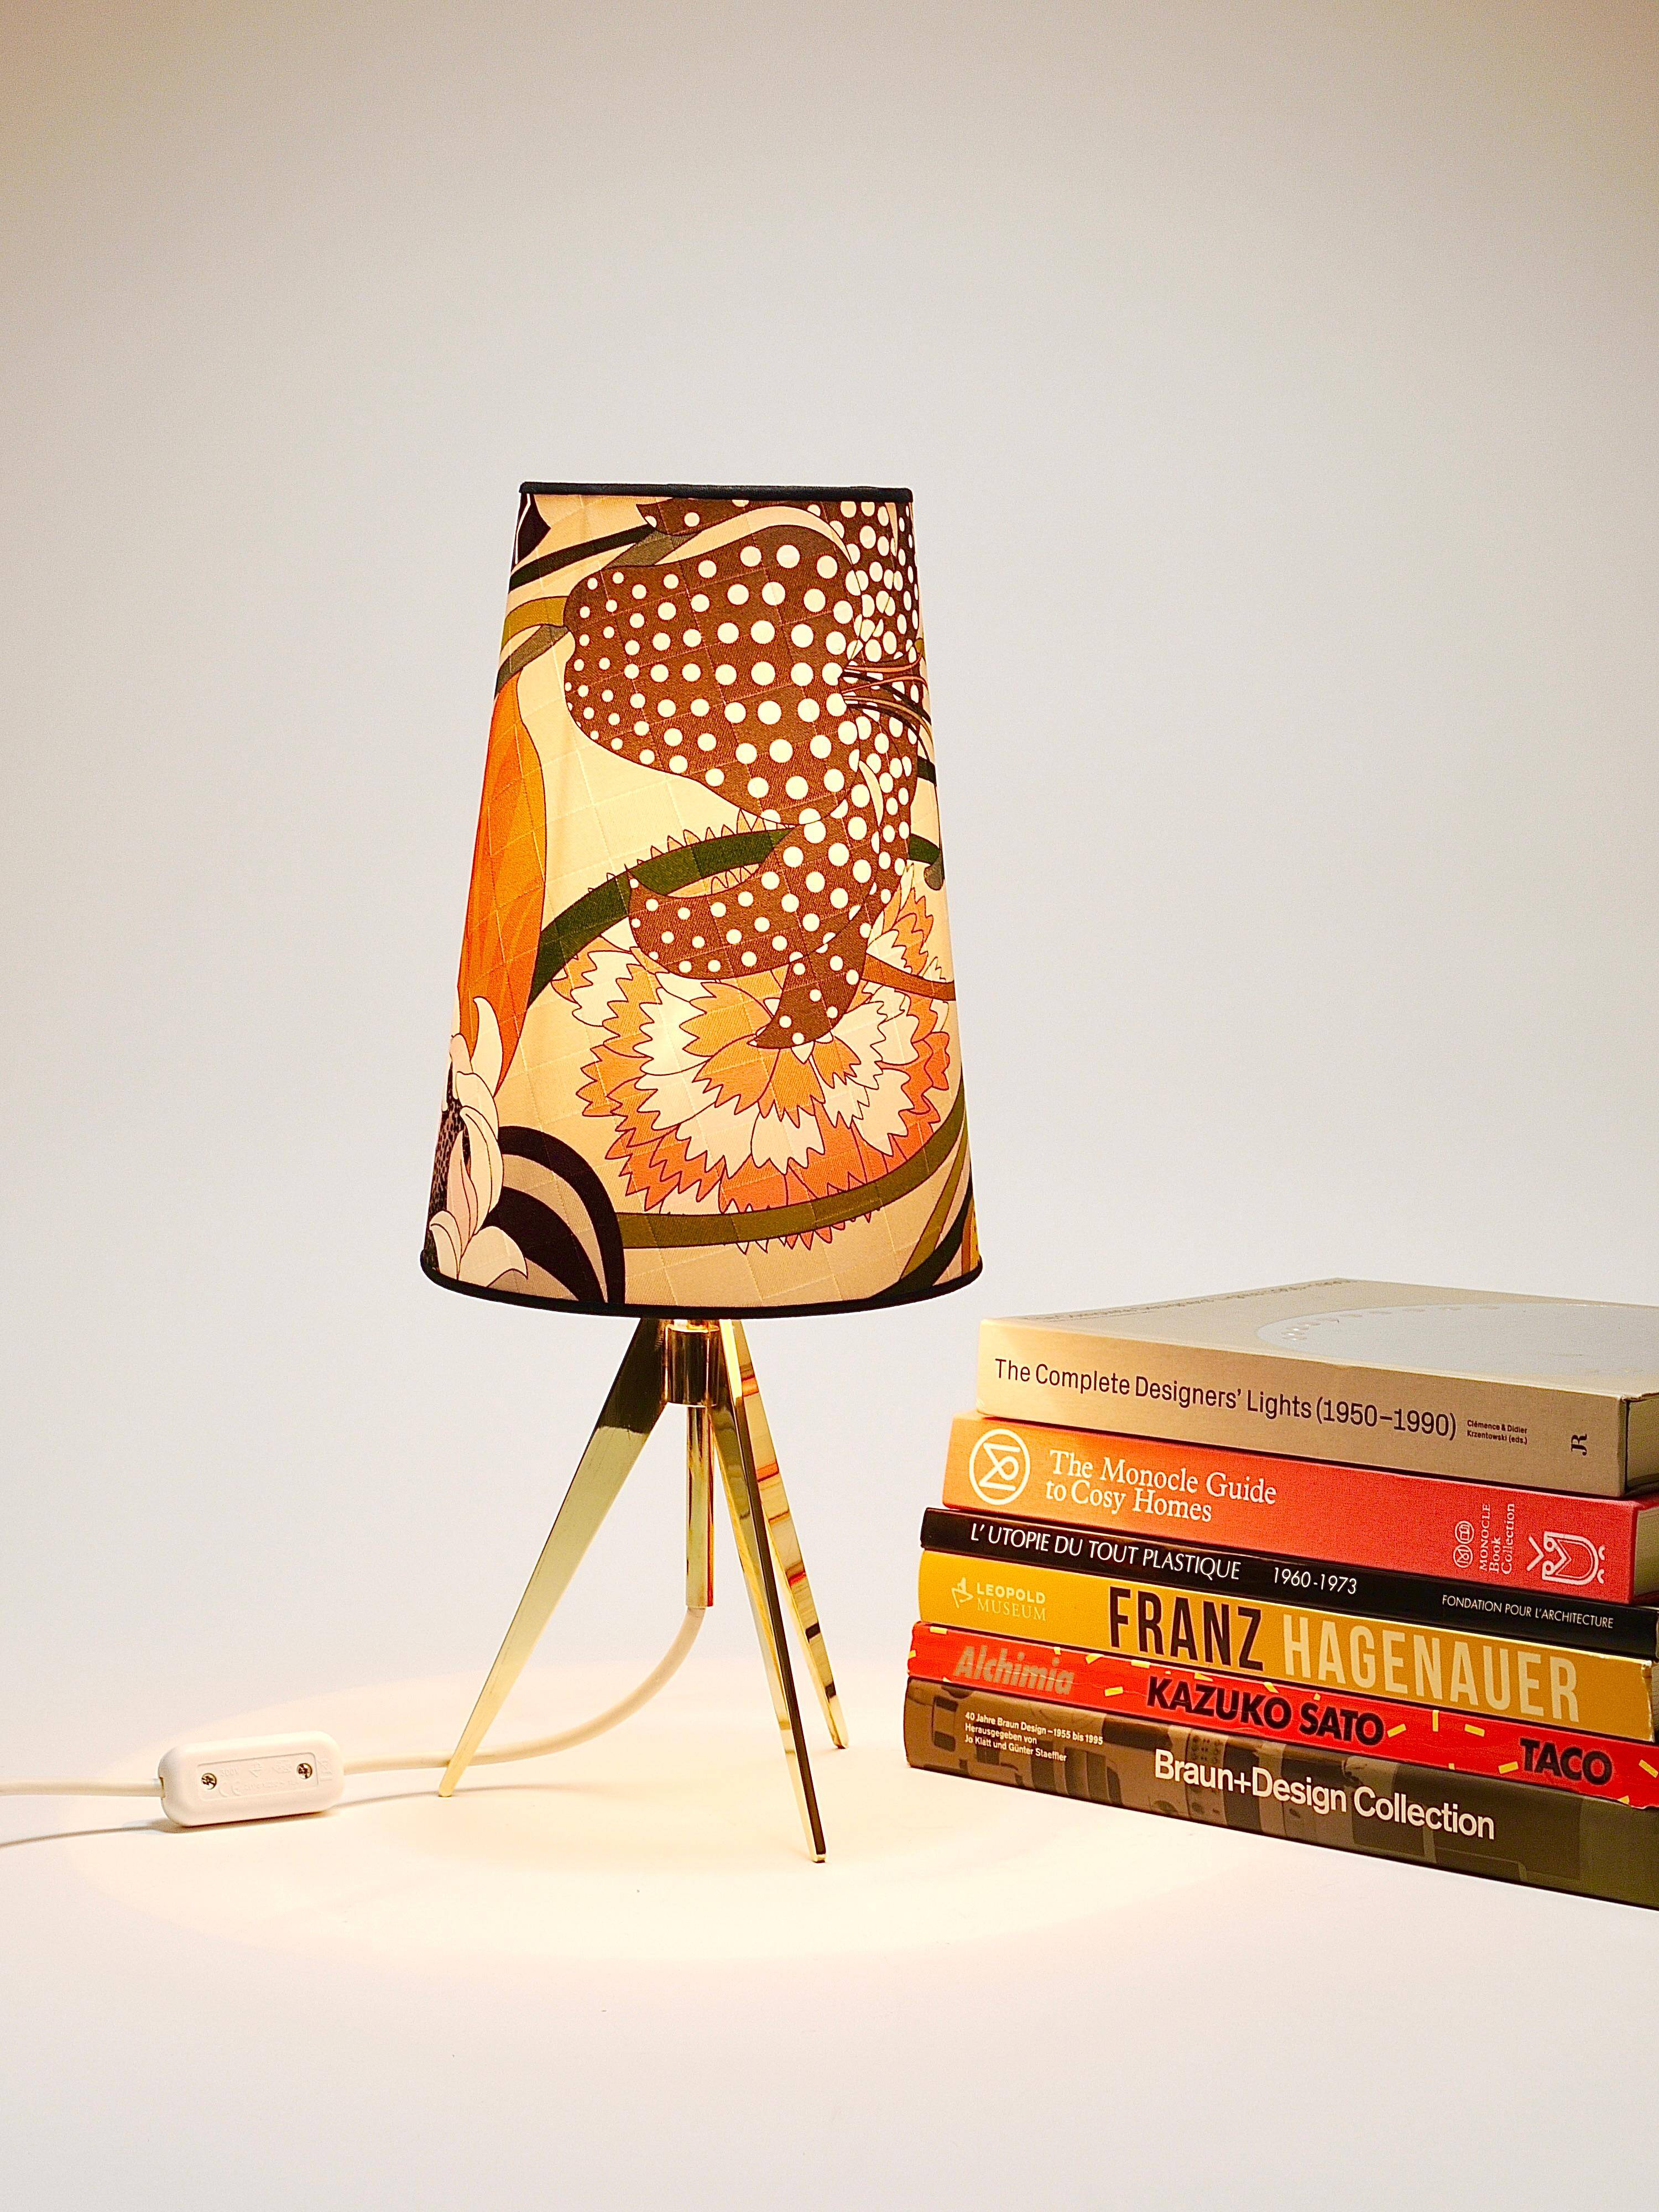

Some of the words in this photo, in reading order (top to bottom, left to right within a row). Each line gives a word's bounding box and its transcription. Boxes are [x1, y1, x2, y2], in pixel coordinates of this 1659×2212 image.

[995, 1359, 1030, 1381] The
[1036, 1363, 1130, 1394] Complete
[1135, 1376, 1241, 1408] Designers’
[1247, 1391, 1312, 1420] Lights
[1467, 1420, 1500, 1431] Clémence
[1507, 1425, 1527, 1433] Didier
[1467, 1430, 1507, 1441] Krzentowski
[1509, 1436, 1527, 1444] (eds.)
[1050, 1450, 1093, 1479] The
[1101, 1457, 1198, 1493] Monocle
[1206, 1472, 1277, 1505] Guide
[1046, 1480, 1067, 1501] to
[1071, 1480, 1126, 1515] Cosy
[1133, 1490, 1212, 1522] Homes
[1479, 1504, 1490, 1571] MONOCLE
[1489, 1536, 1501, 1573] Book
[1501, 1504, 1515, 1574] Collection
[1055, 1535, 1082, 1556] DU
[1088, 1540, 1139, 1564] TOUT
[1142, 1549, 1241, 1581] PLASTIQUE
[1274, 1567, 1358, 1595] 1960-1973
[977, 1582, 1046, 1604] LEOPOLD
[977, 1598, 1046, 1621] MUSEUM
[1442, 1594, 1503, 1613] FONDATION
[1505, 1604, 1532, 1618] POUR
[1535, 1608, 1614, 1629] L'ARCHITECTURE
[953, 1645, 1074, 1695] Alchimia
[1109, 1586, 1264, 1671] FRANZ
[1282, 1614, 1580, 1723] HAGENAUER
[965, 1712, 975, 1720] 40
[976, 1713, 995, 1725] Jahre
[997, 1717, 1019, 1729] Braun
[1021, 1721, 1046, 1735] Design
[1072, 1731, 1084, 1741] bis
[1085, 1734, 1103, 1745] 1995
[1147, 1676, 1292, 1729] KAZUKO
[1299, 1702, 1385, 1746] SATO
[965, 1723, 1022, 1741] Herausgegeben
[1024, 1736, 1037, 1745] von
[965, 1734, 973, 1744] Jo
[975, 1736, 992, 1747] Klatt
[993, 1740, 1007, 1750] und
[1008, 1743, 1034, 1755] Günter
[1035, 1747, 1067, 1762] Staeffler
[1519, 1738, 1612, 1786] TACO
[1155, 1748, 1347, 1814] Braun+Design
[1353, 1786, 1495, 1840] Collection
